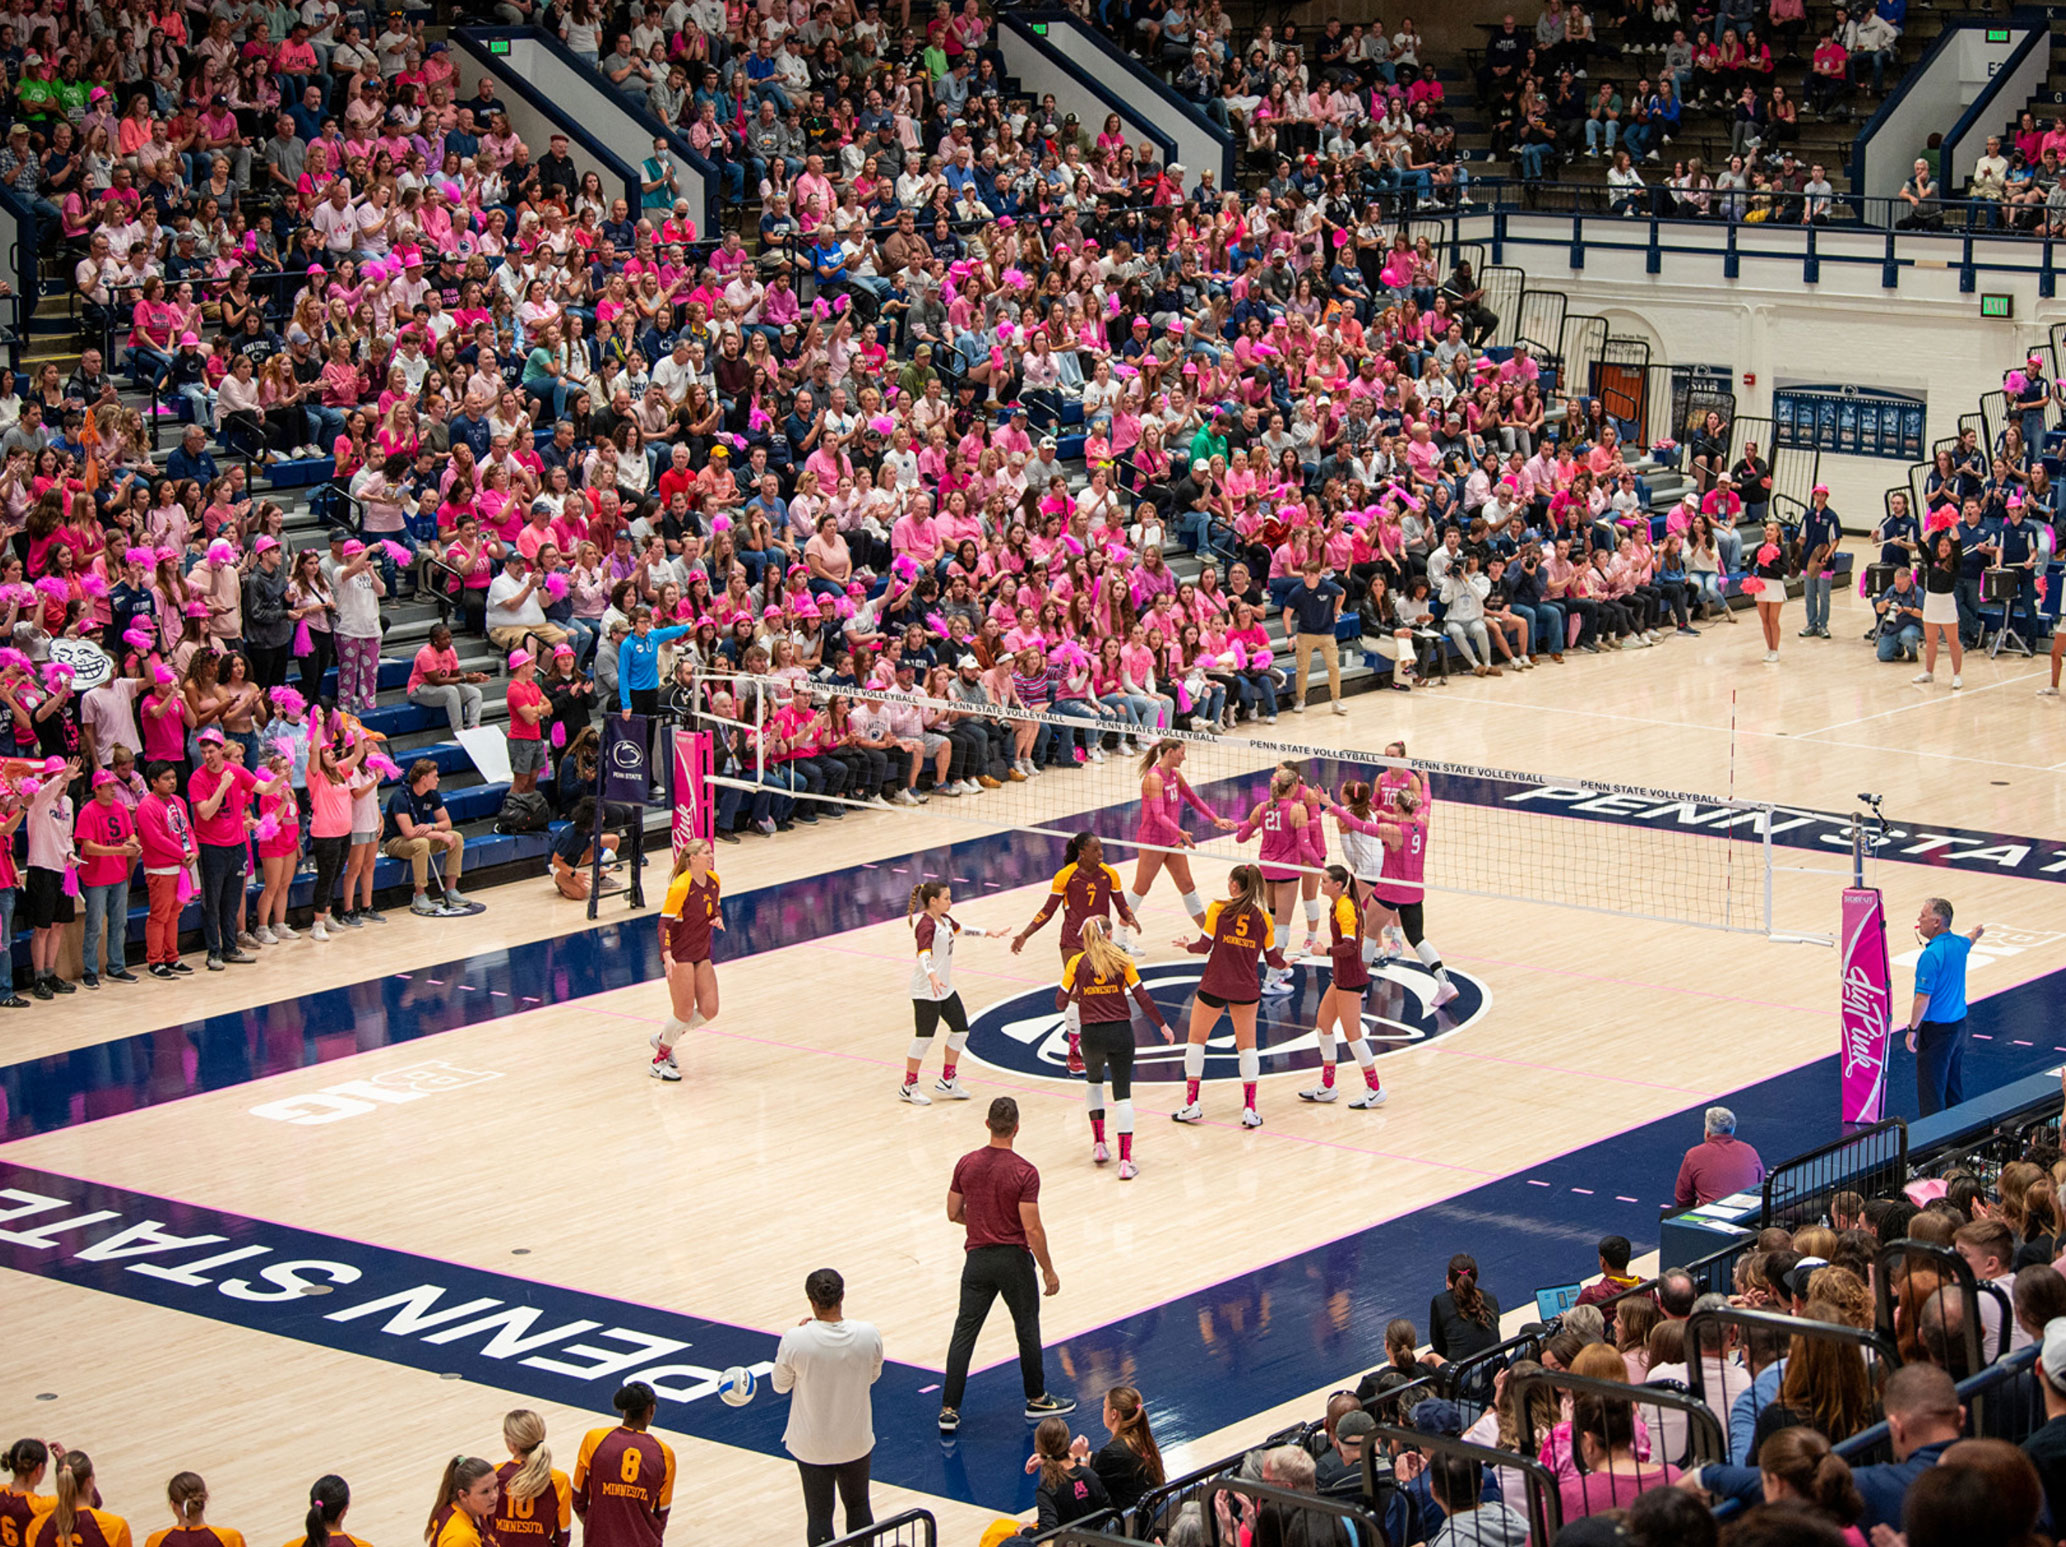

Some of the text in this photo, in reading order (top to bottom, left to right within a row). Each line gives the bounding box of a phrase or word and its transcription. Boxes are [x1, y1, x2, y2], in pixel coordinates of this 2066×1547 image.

[1986, 297, 2008, 315] EXIT
[805, 681, 919, 704] PENN STATE VOLLEYBALL
[948, 701, 1066, 723] PENN STATE VOLLEYBALL
[1095, 720, 1218, 743] PENN STATE VOLLEYBALL
[1249, 739, 1379, 763] PENN STATE VOLLEYBALL
[1411, 759, 1545, 784] PENN STATE VOLLEYBALL
[1580, 780, 1720, 805] PENN STATE VOLLEYBALL
[107, 816, 121, 837] S
[1264, 810, 1282, 832] 21
[1410, 834, 1421, 855] 9
[1087, 891, 1097, 907] 7
[1235, 914, 1251, 938] 5
[1083, 984, 1120, 997] MINNESOTA
[620, 1447, 642, 1484] 8
[506, 1484, 535, 1520] 10
[495, 1517, 544, 1534] MINNESOTA
